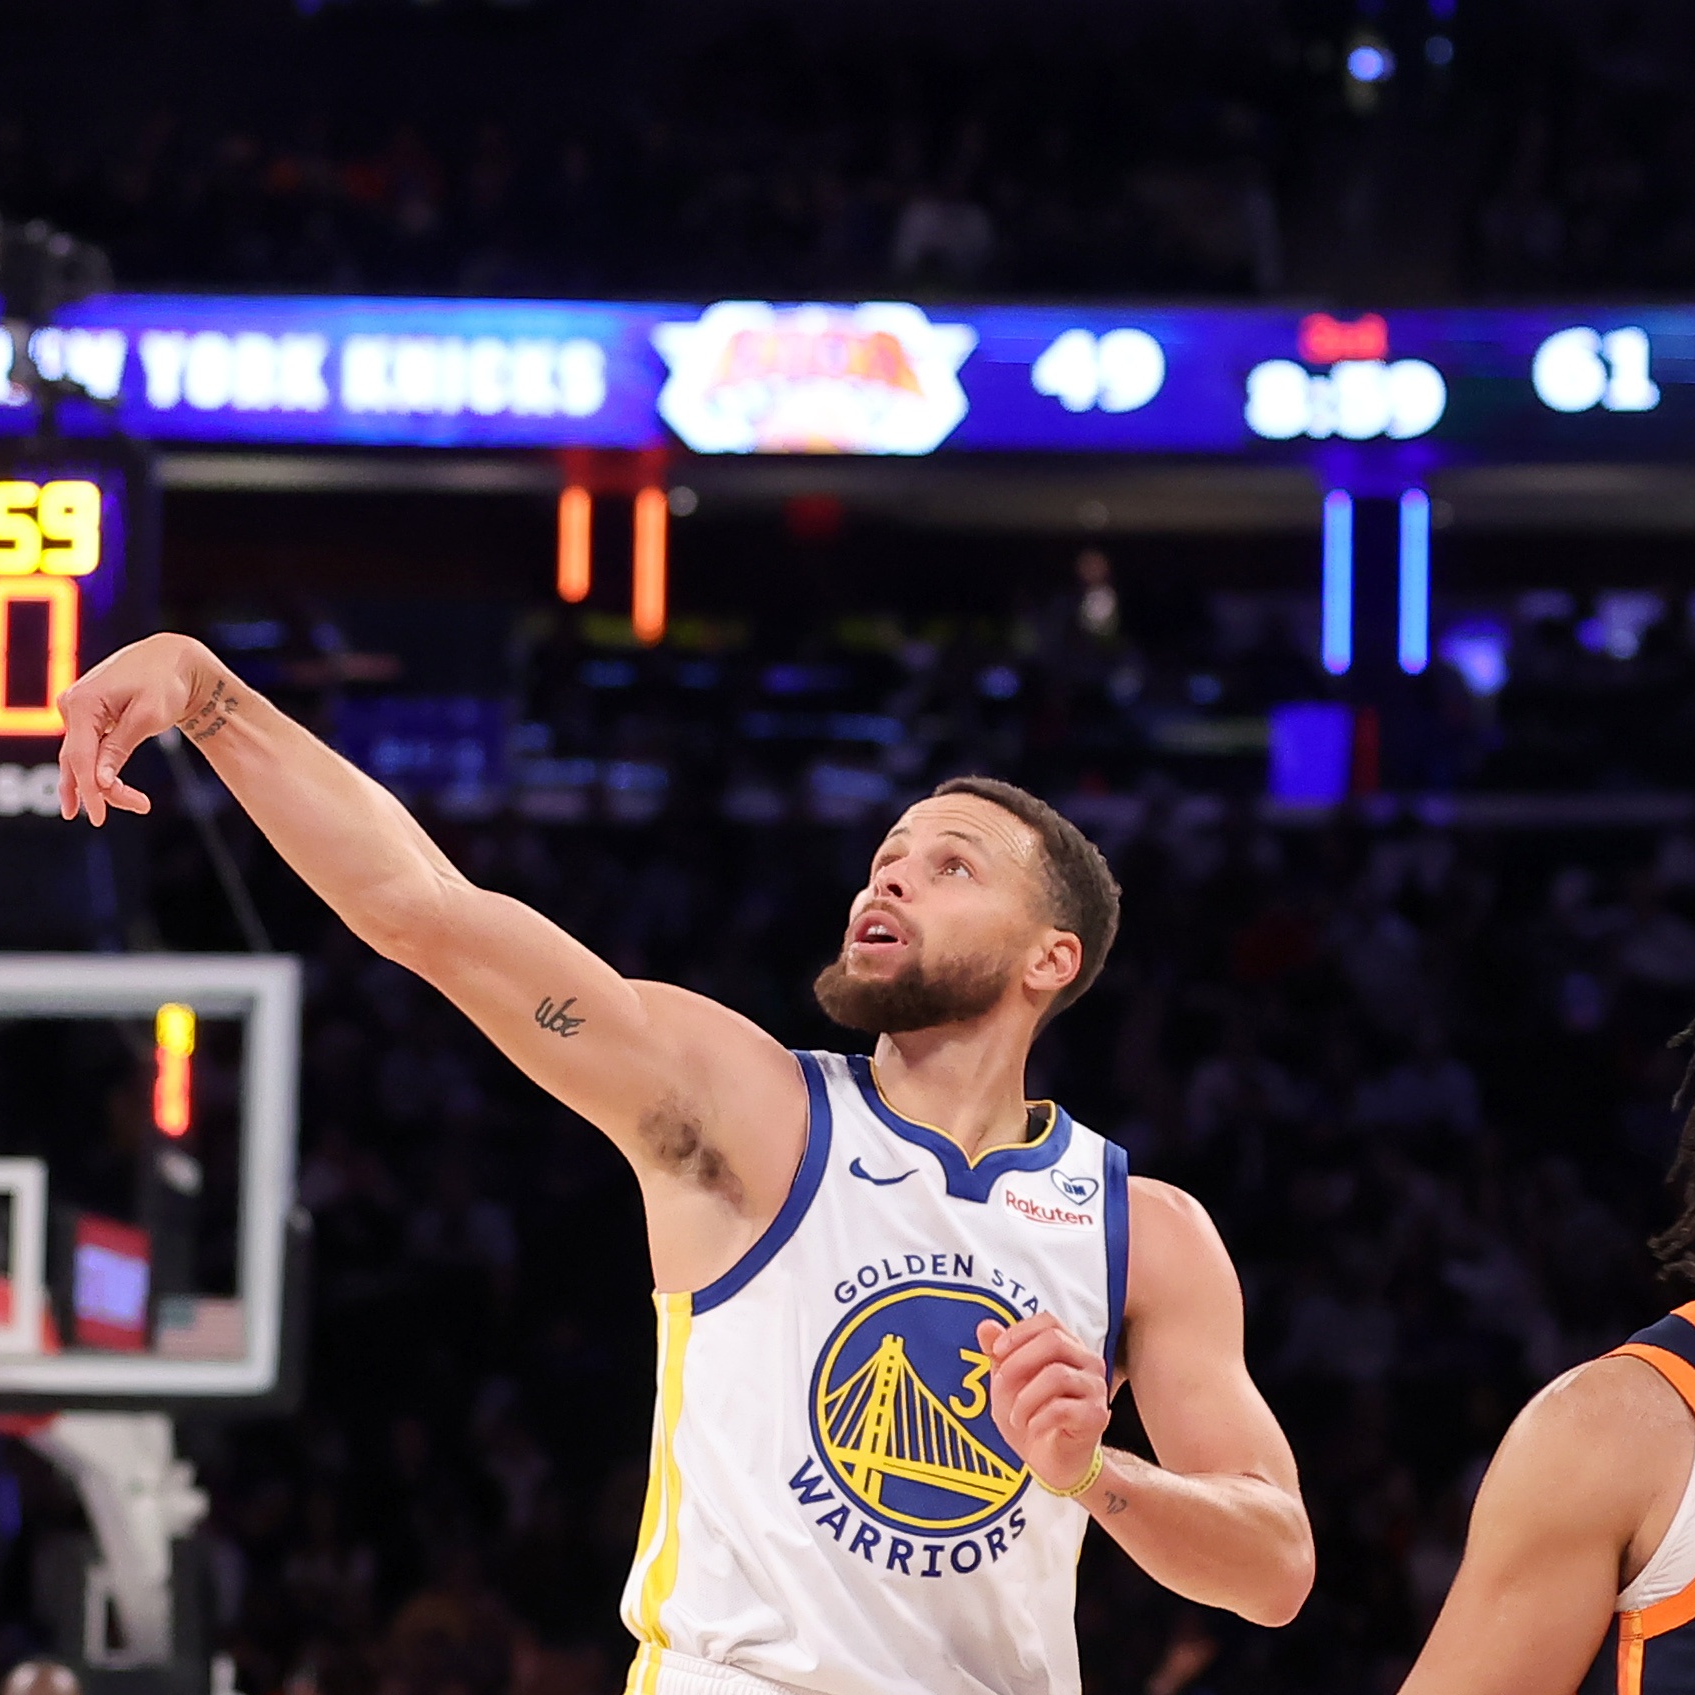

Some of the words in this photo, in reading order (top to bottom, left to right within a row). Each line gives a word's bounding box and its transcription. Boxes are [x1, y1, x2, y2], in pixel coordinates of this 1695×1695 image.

[137, 330, 331, 413] YORK
[340, 332, 609, 417] KNICKS
[1031, 328, 1166, 413] 49
[1244, 358, 1447, 440] 8:59
[1531, 326, 1661, 414] 61
[1005, 1189, 1094, 1226] Rakuten
[834, 1253, 974, 1305] GOLDEN
[991, 1268, 1040, 1316] STA
[948, 1348, 991, 1420] 3
[788, 1456, 1027, 1578] WARRIORS
